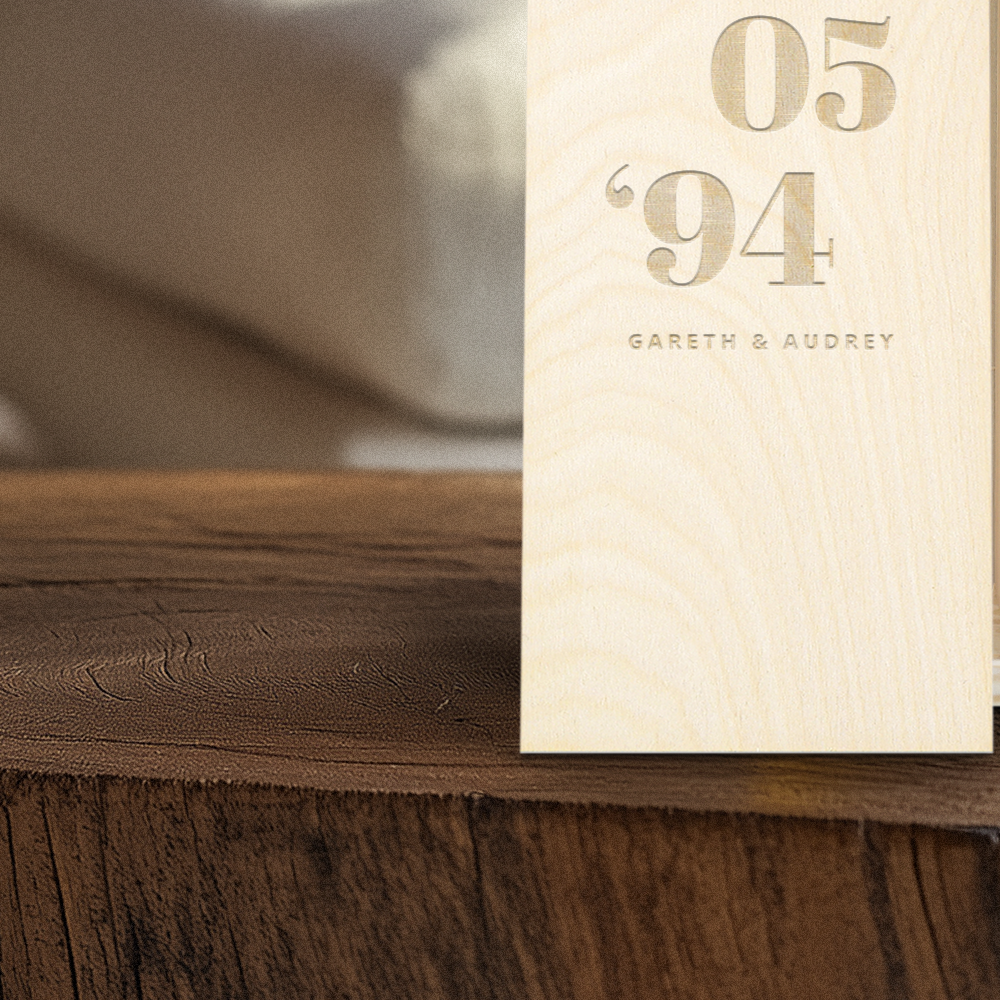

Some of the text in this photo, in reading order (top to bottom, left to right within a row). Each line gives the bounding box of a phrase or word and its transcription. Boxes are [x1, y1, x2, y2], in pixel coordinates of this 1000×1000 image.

[710, 15, 897, 132] 05
[628, 333, 895, 350] GARETH & AUDREY
